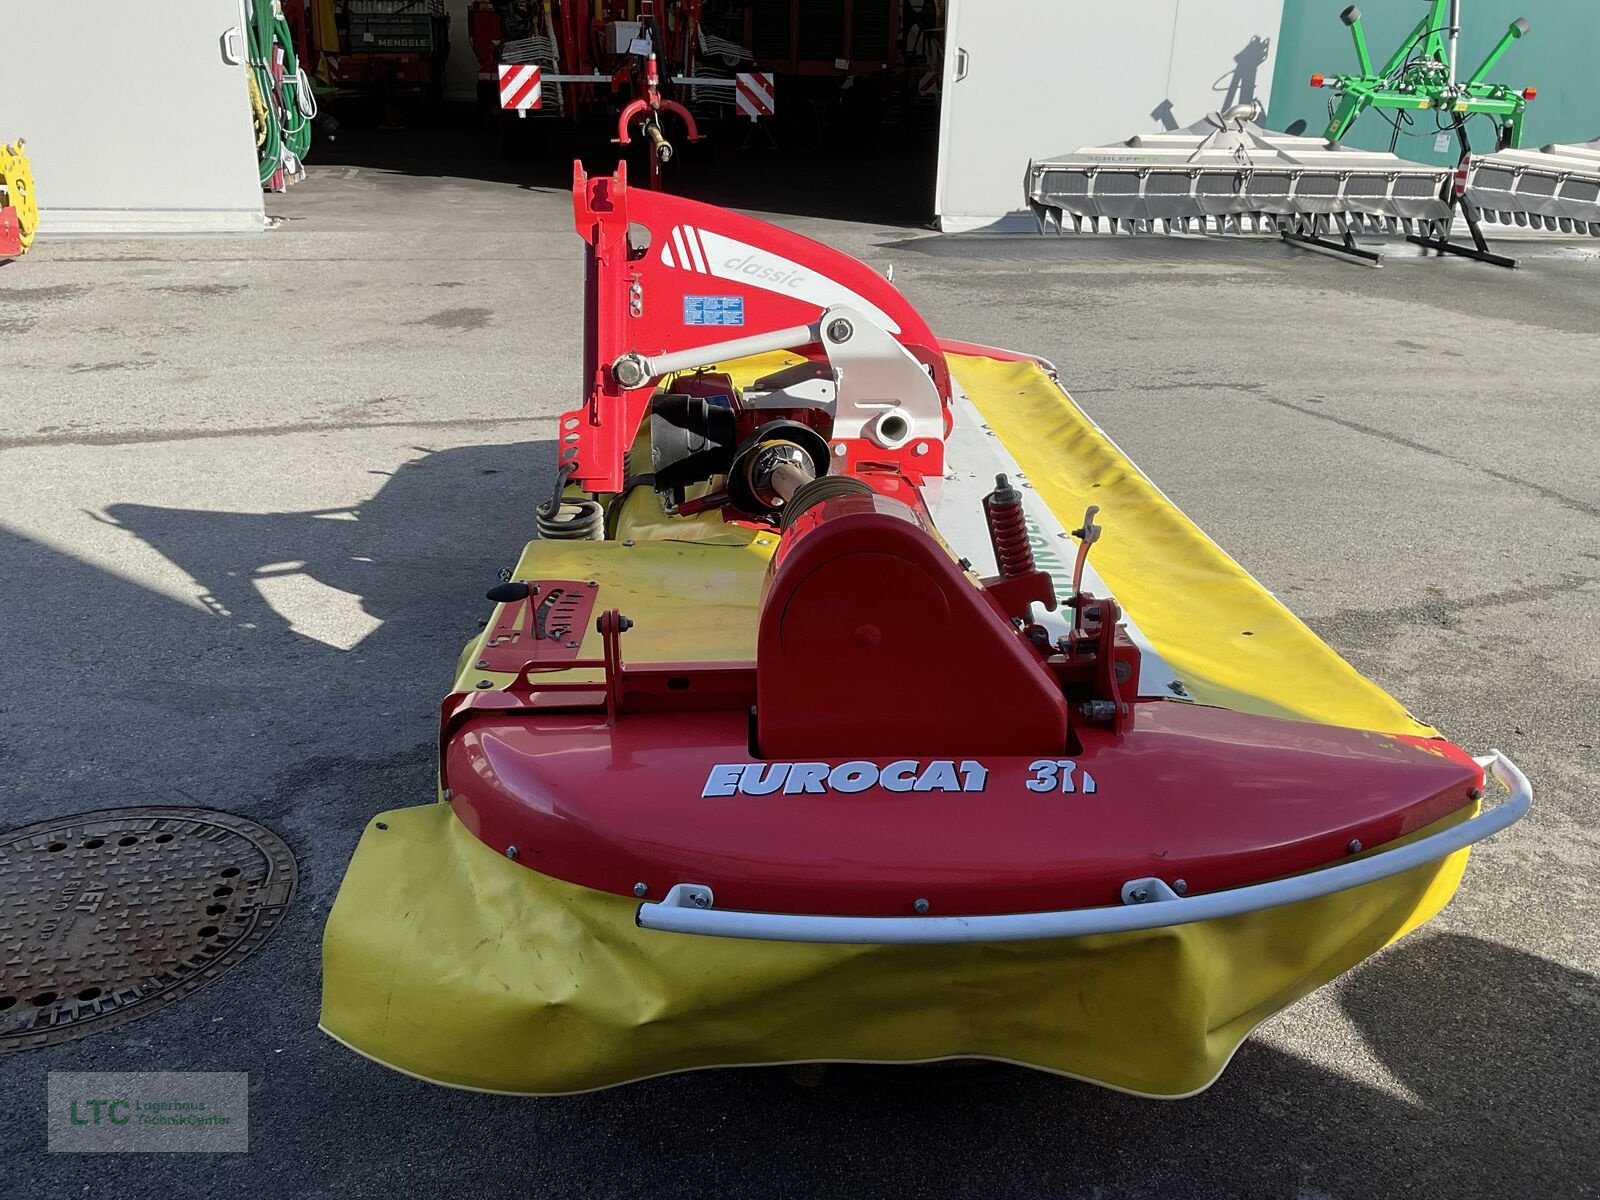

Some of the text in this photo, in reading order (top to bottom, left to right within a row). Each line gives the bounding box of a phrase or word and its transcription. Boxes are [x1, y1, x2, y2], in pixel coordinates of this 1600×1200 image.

[378, 39, 430, 47] MENGELE
[723, 255, 806, 289] classic
[701, 760, 989, 798] EUROCAT
[51, 880, 83, 912] EURO
[75, 880, 110, 915] AET
[39, 916, 62, 940] TOP
